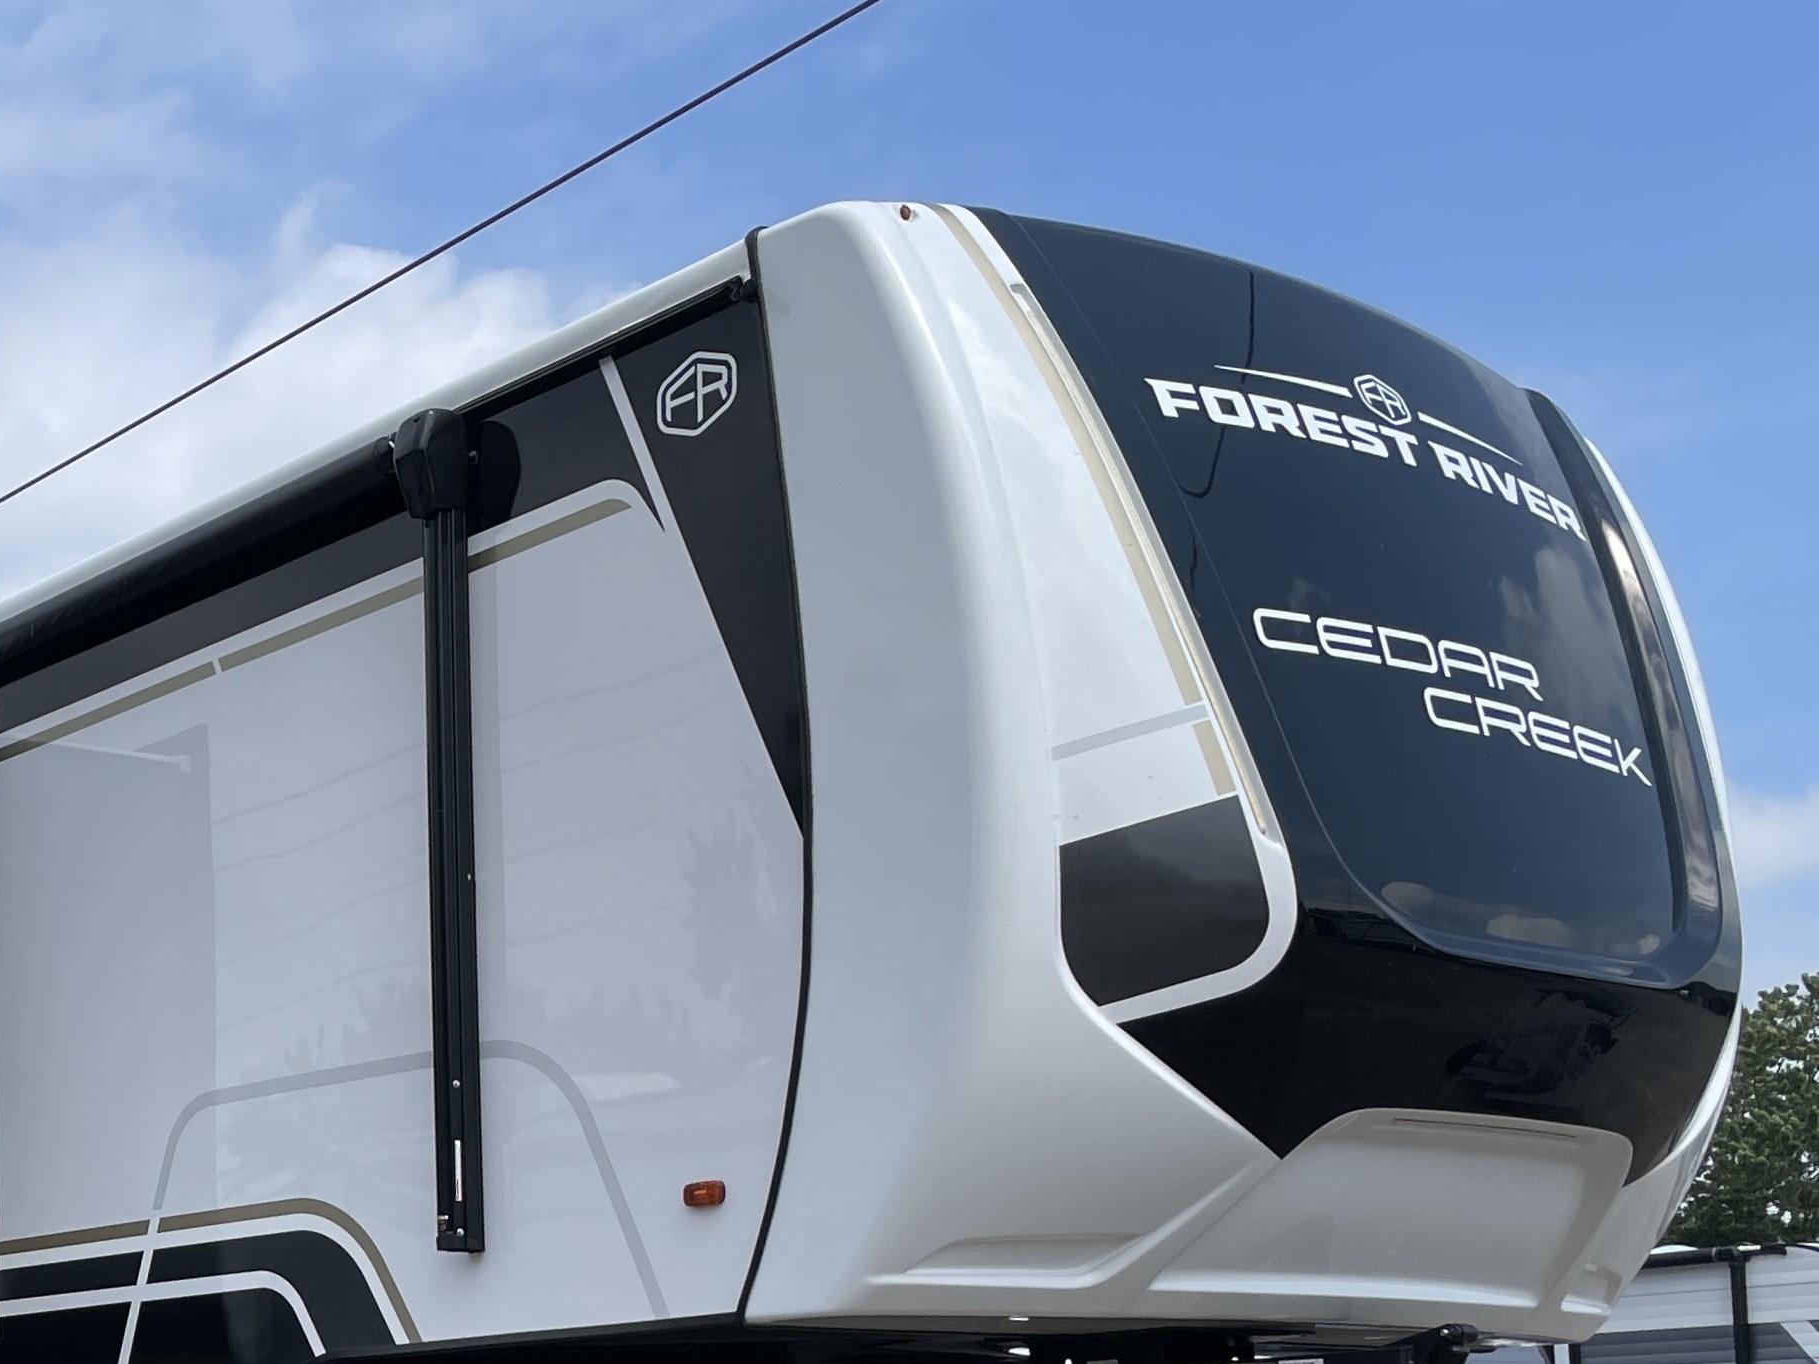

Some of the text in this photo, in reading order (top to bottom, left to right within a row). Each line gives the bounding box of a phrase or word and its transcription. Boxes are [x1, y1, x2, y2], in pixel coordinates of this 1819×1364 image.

[1144, 378, 1587, 542] FOREST RIVER
[1252, 607, 1544, 701] CEDAR
[1423, 686, 1652, 787] CREEK
